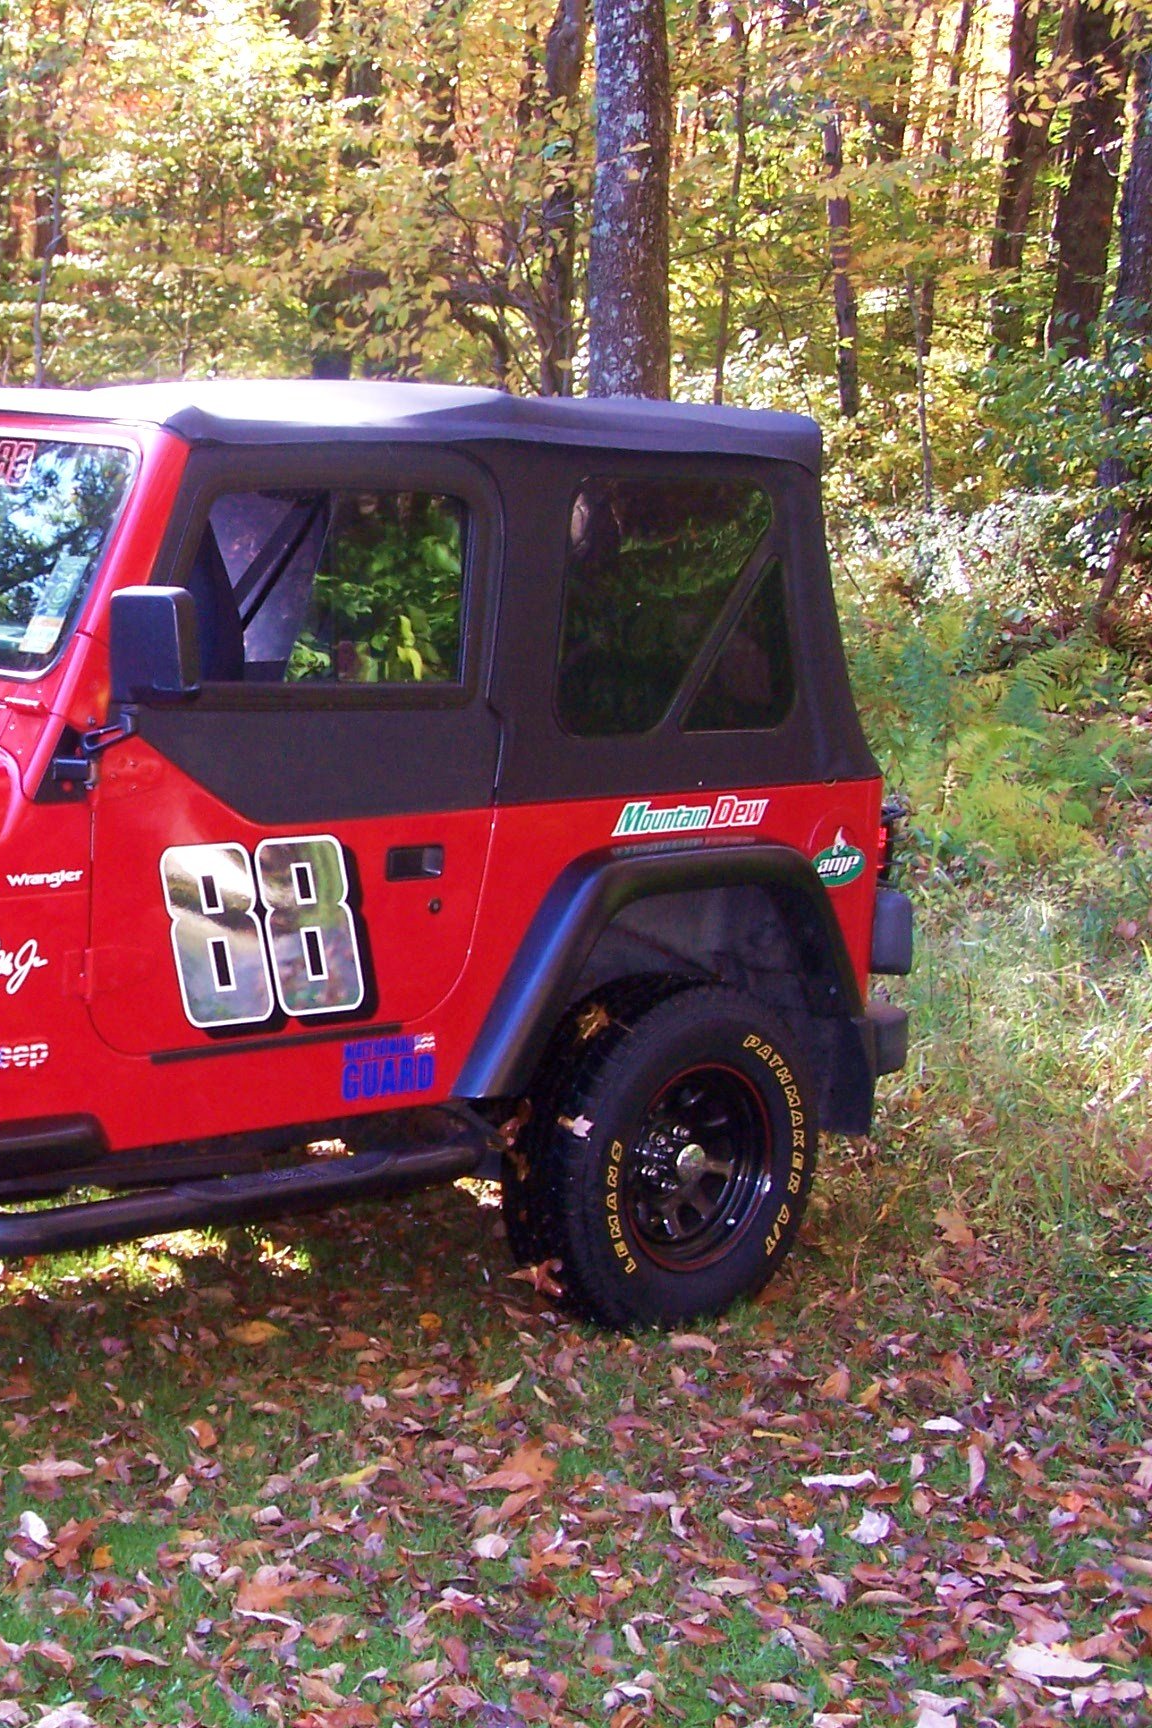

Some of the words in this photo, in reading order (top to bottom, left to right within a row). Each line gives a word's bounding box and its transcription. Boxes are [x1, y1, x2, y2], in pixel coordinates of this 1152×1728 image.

[611, 802, 711, 836] Mountain
[708, 796, 769, 828] Dew
[6, 869, 83, 888] Wrangler
[159, 834, 364, 1028] 88
[342, 1053, 435, 1101] GUARD
[743, 1034, 805, 1194] PATHMAKER
[606, 1140, 637, 1274] LEMANS
[765, 1203, 791, 1256] A/T
